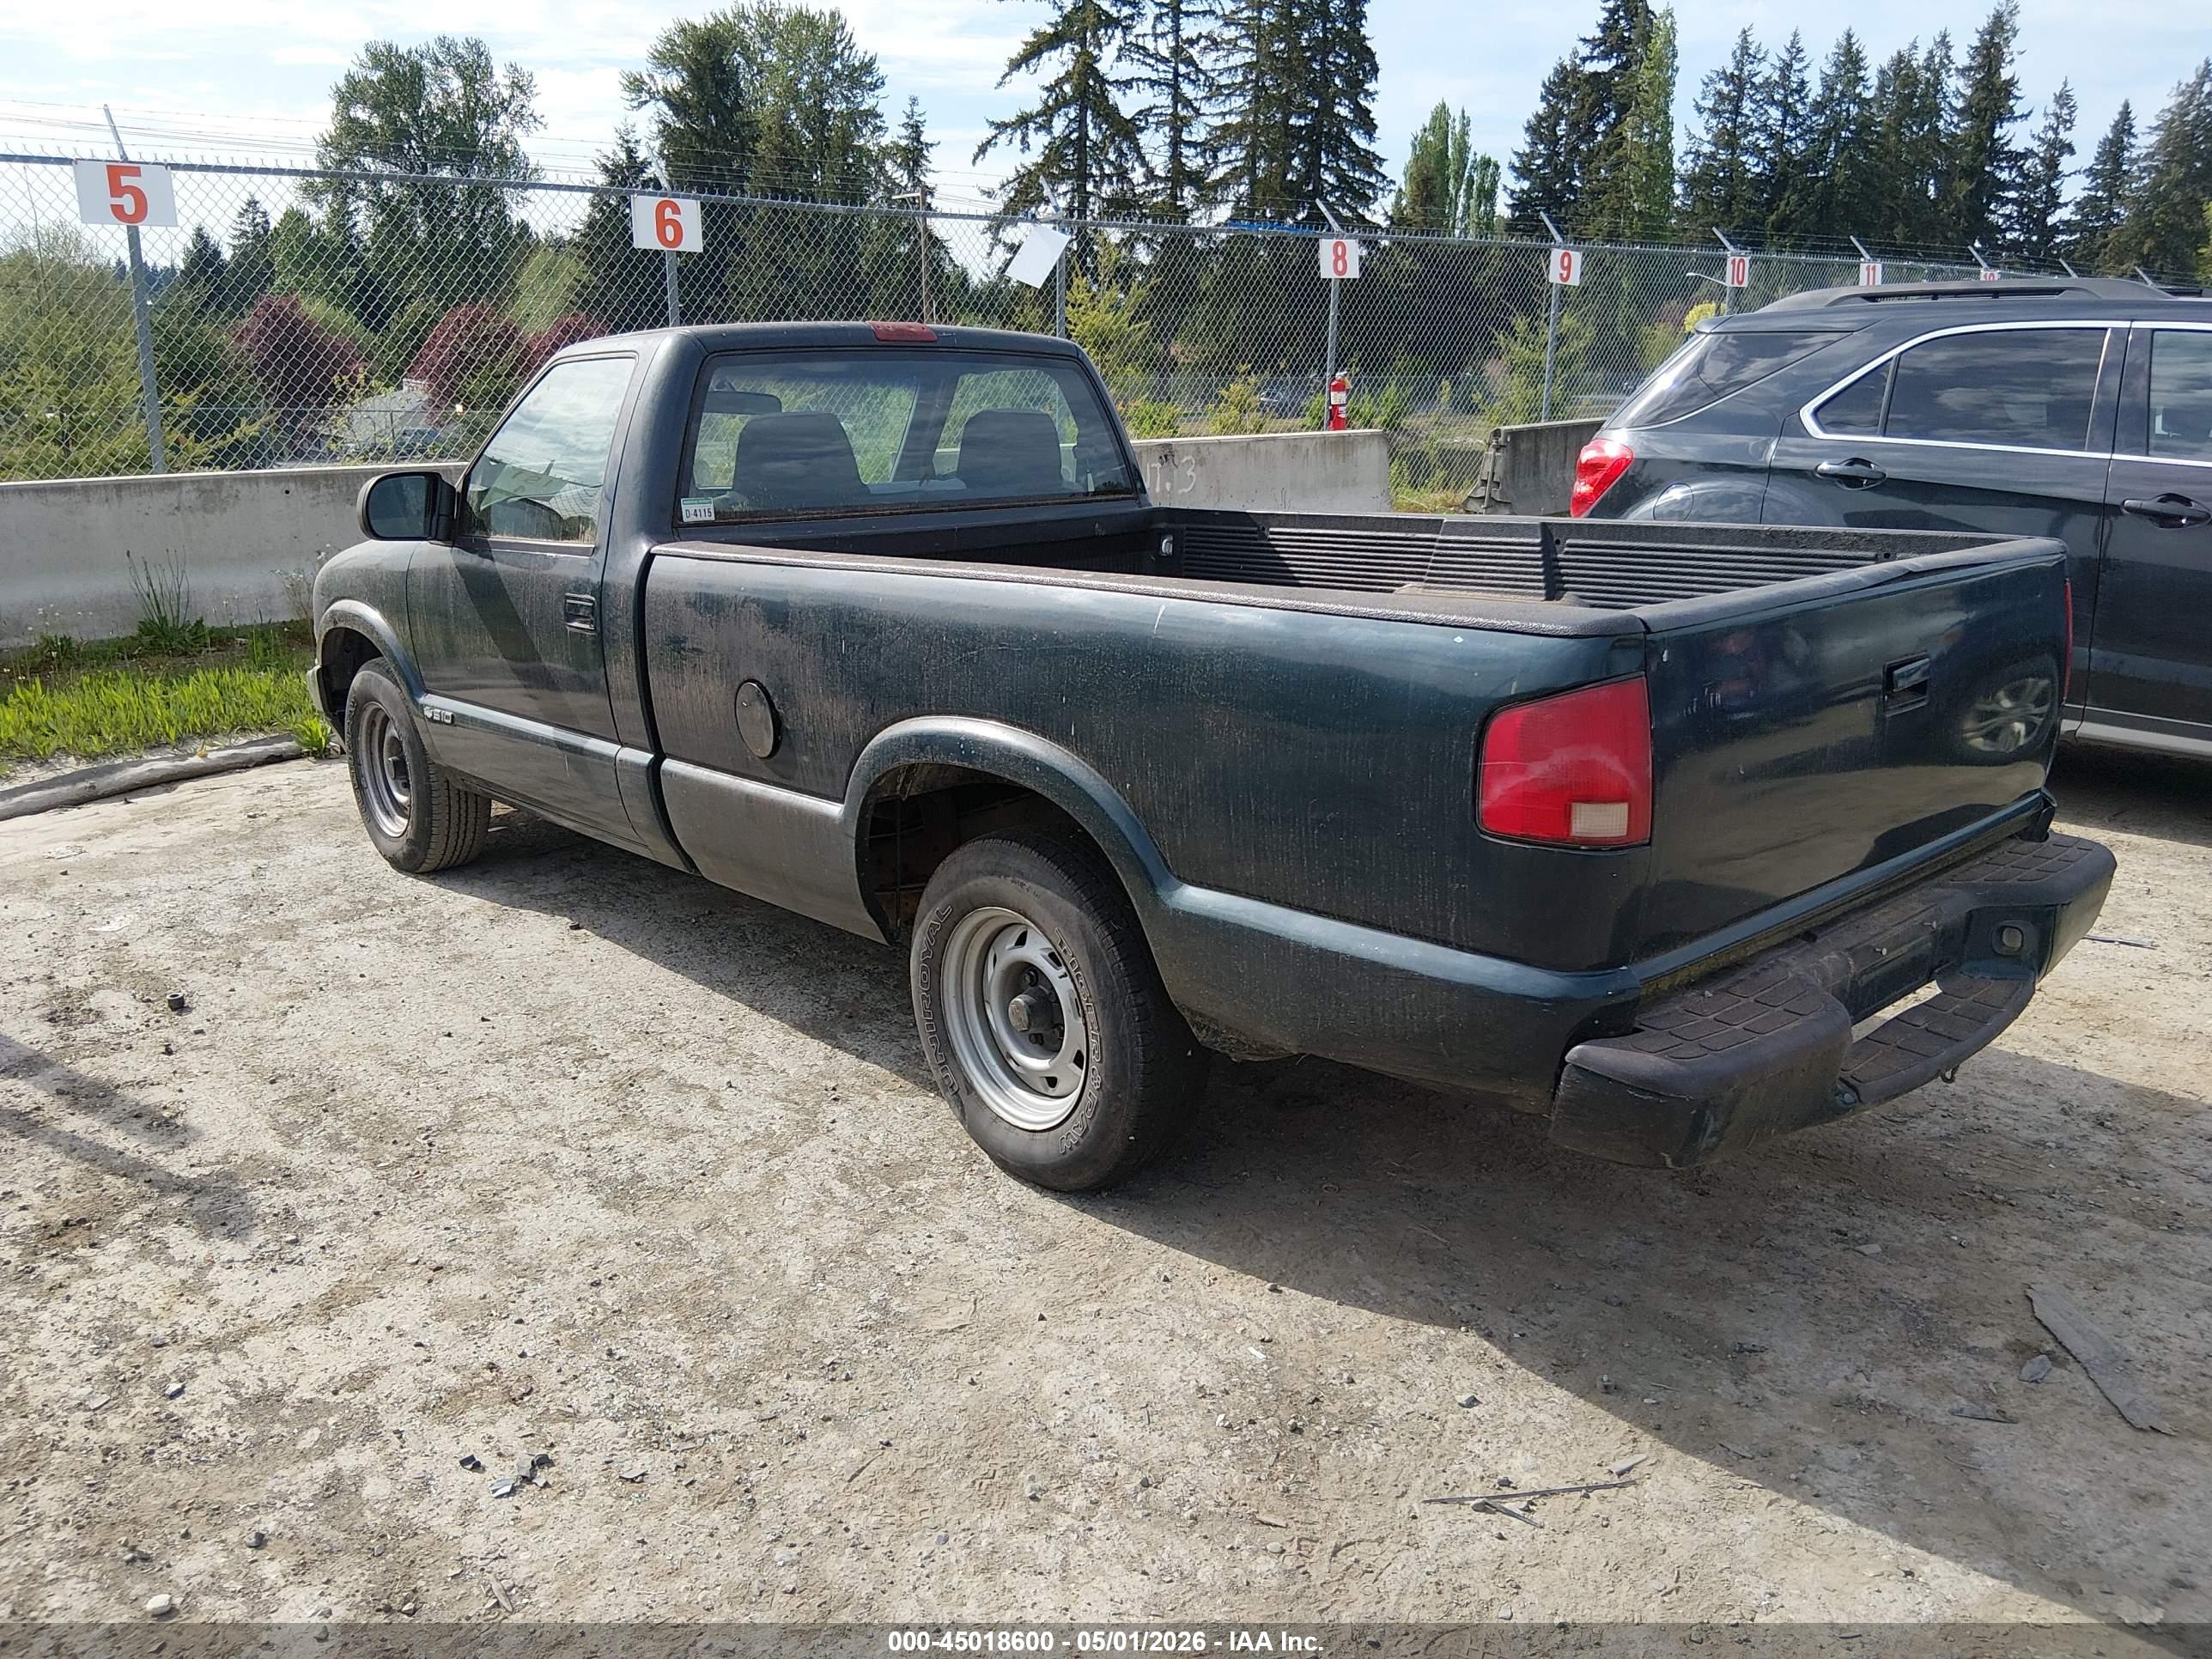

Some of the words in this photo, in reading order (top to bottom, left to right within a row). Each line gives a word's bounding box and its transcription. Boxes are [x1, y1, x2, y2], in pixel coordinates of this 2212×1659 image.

[106, 164, 148, 224] 5
[655, 199, 684, 249] 6
[1332, 240, 1347, 276] 8
[1559, 252, 1572, 283] 9
[1730, 258, 1746, 285] 10
[1865, 264, 1876, 286] 11
[919, 905, 959, 1096] UNIROYAL
[1054, 927, 1103, 1063] TIGER
[1059, 1089, 1098, 1154] PAW
